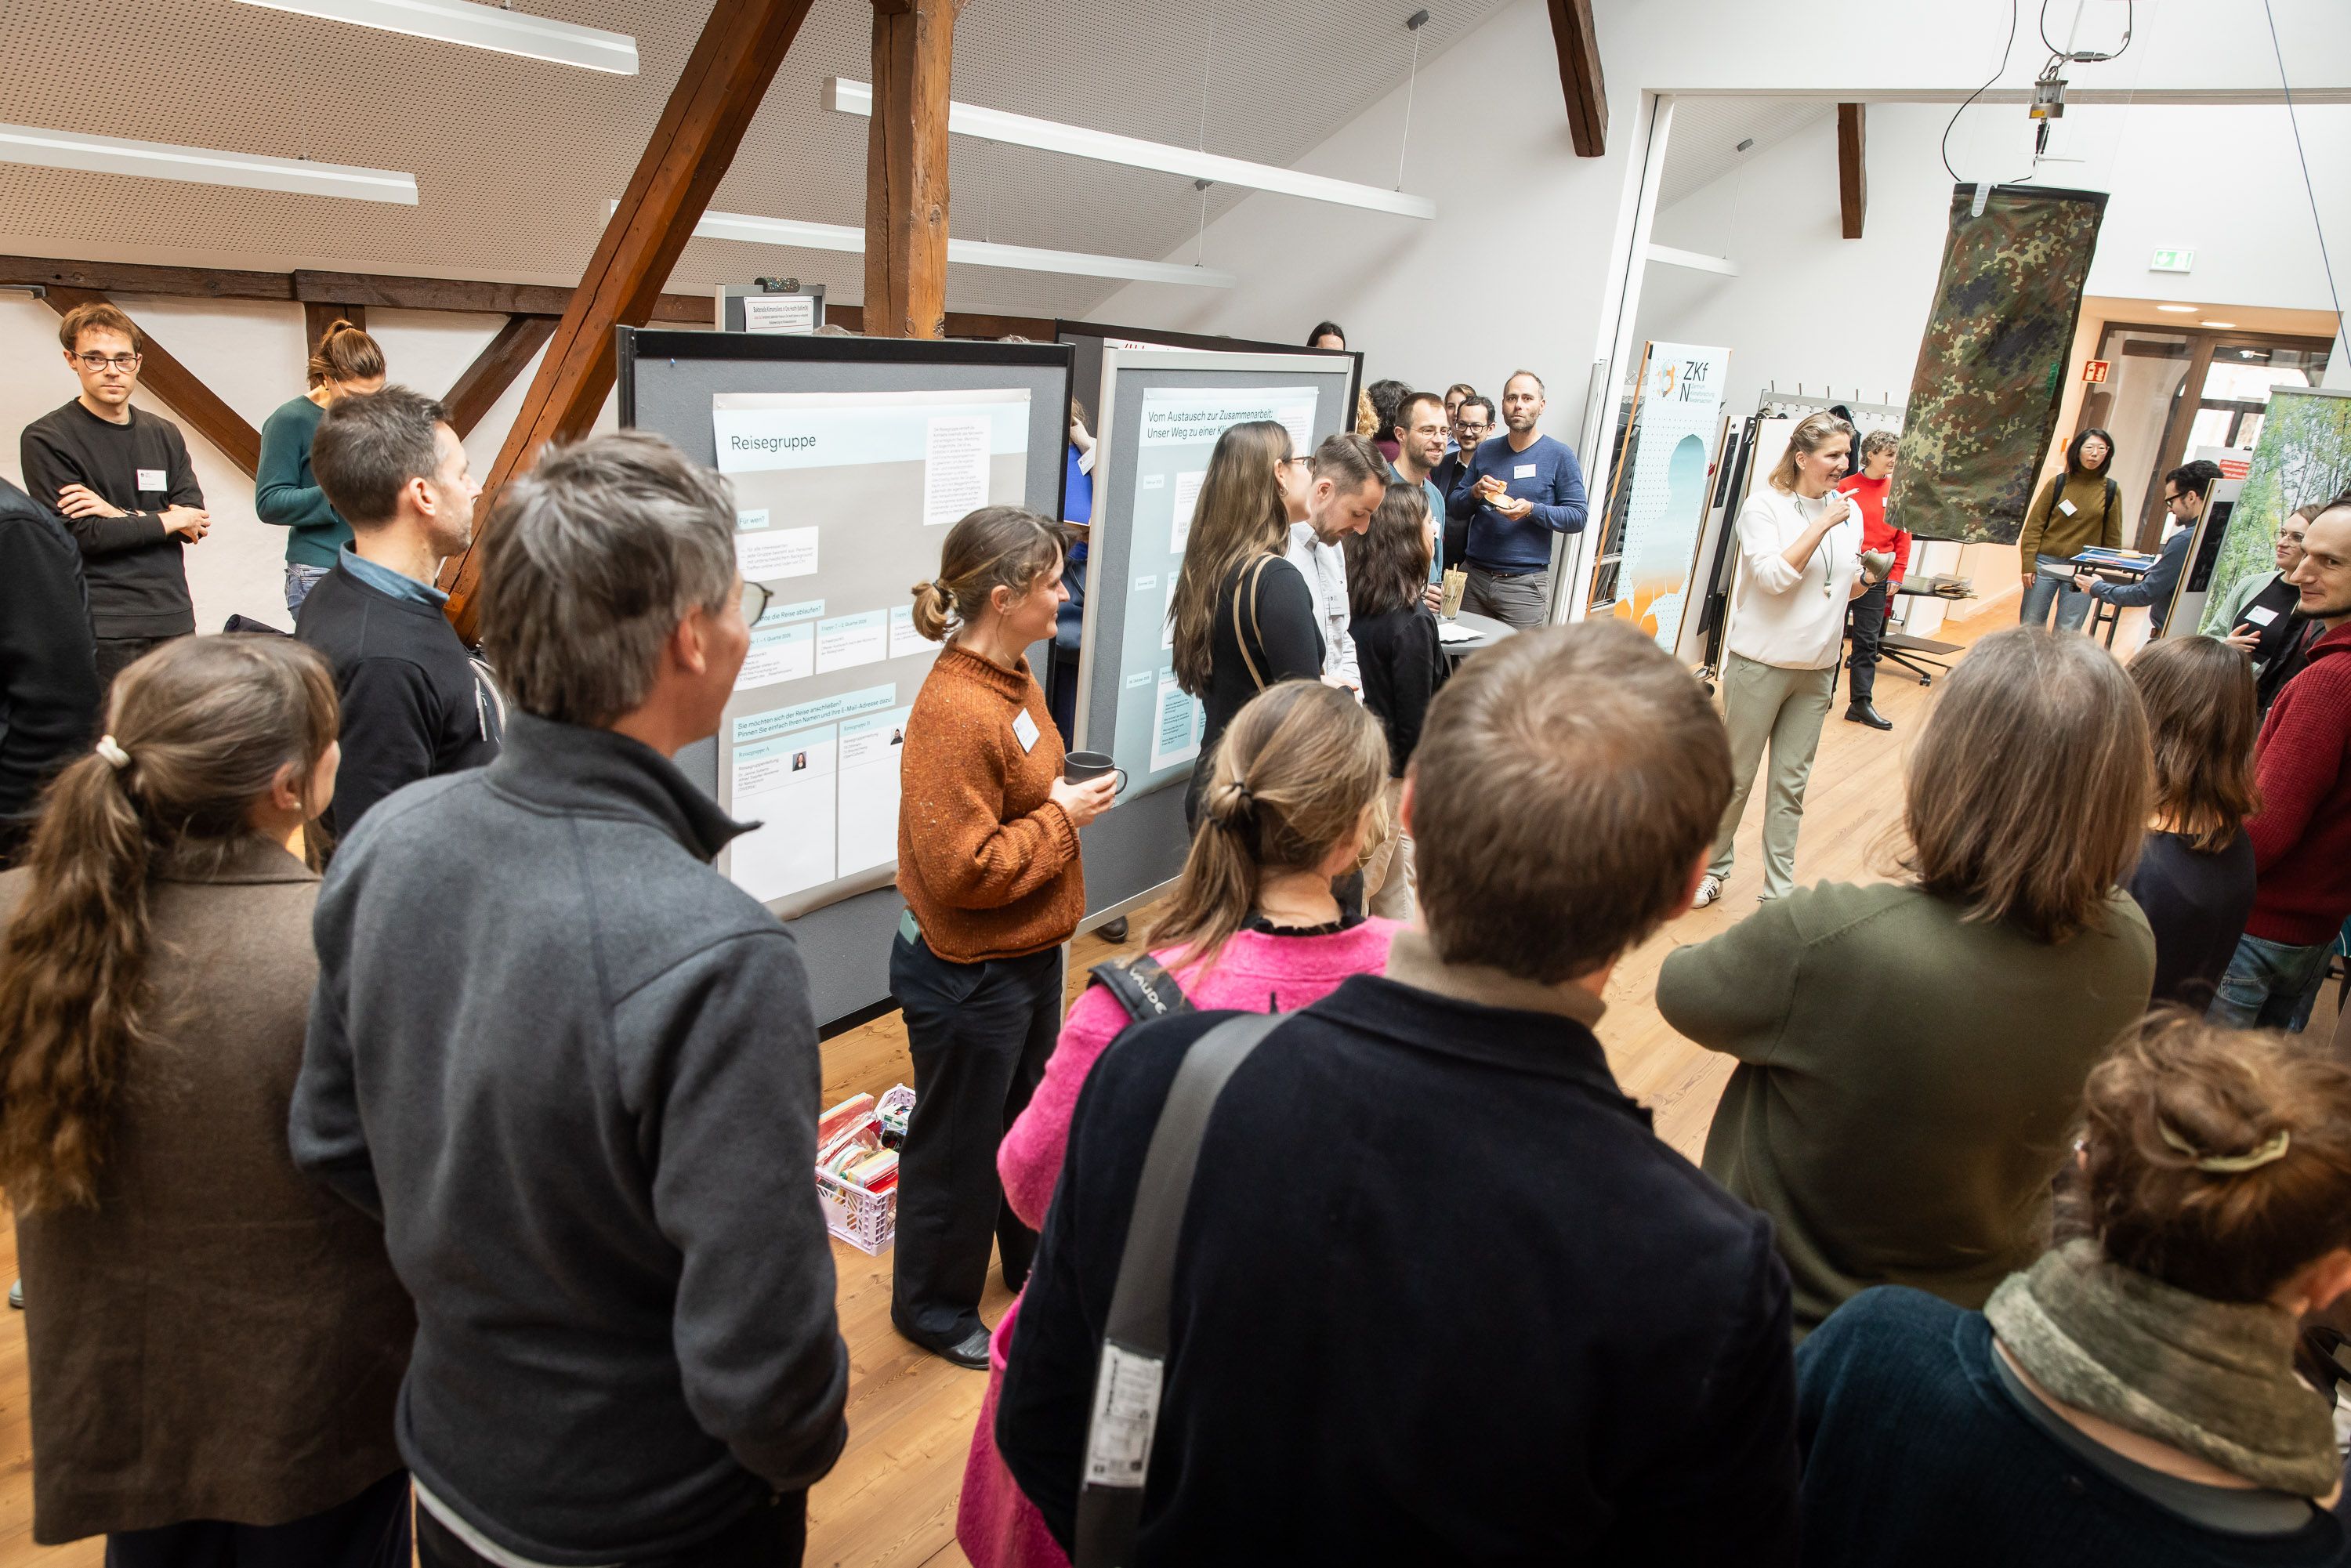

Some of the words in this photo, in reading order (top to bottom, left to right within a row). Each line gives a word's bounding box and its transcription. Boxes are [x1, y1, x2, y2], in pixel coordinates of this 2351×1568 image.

[1683, 361, 1709, 381] ZKf
[1680, 383, 1691, 402] N
[1148, 411, 1166, 422] Vom
[1167, 410, 1206, 422] Austausch
[1207, 413, 1218, 422] zur
[1219, 408, 1273, 420] Zusammenarbeit:
[1147, 427, 1170, 439] Unser
[1171, 427, 1187, 440] Weg
[1189, 428, 1197, 437] zu
[1199, 426, 1216, 436] einer
[731, 436, 816, 453] Reisegruppe
[739, 517, 749, 525] Für
[796, 606, 821, 616] ablaufen?
[738, 728, 758, 737] Pinnen
[768, 722, 788, 731] einfach
[789, 719, 802, 728] Ihren
[803, 715, 820, 724] Namen
[822, 711, 831, 719] und
[831, 708, 840, 717] Ihre
[841, 700, 879, 714] E-Mail-Adresse
[879, 695, 892, 705] dazu!
[748, 718, 773, 728] möchten
[774, 714, 785, 722] sich
[786, 712, 794, 720] der
[810, 700, 842, 713] anschließen?
